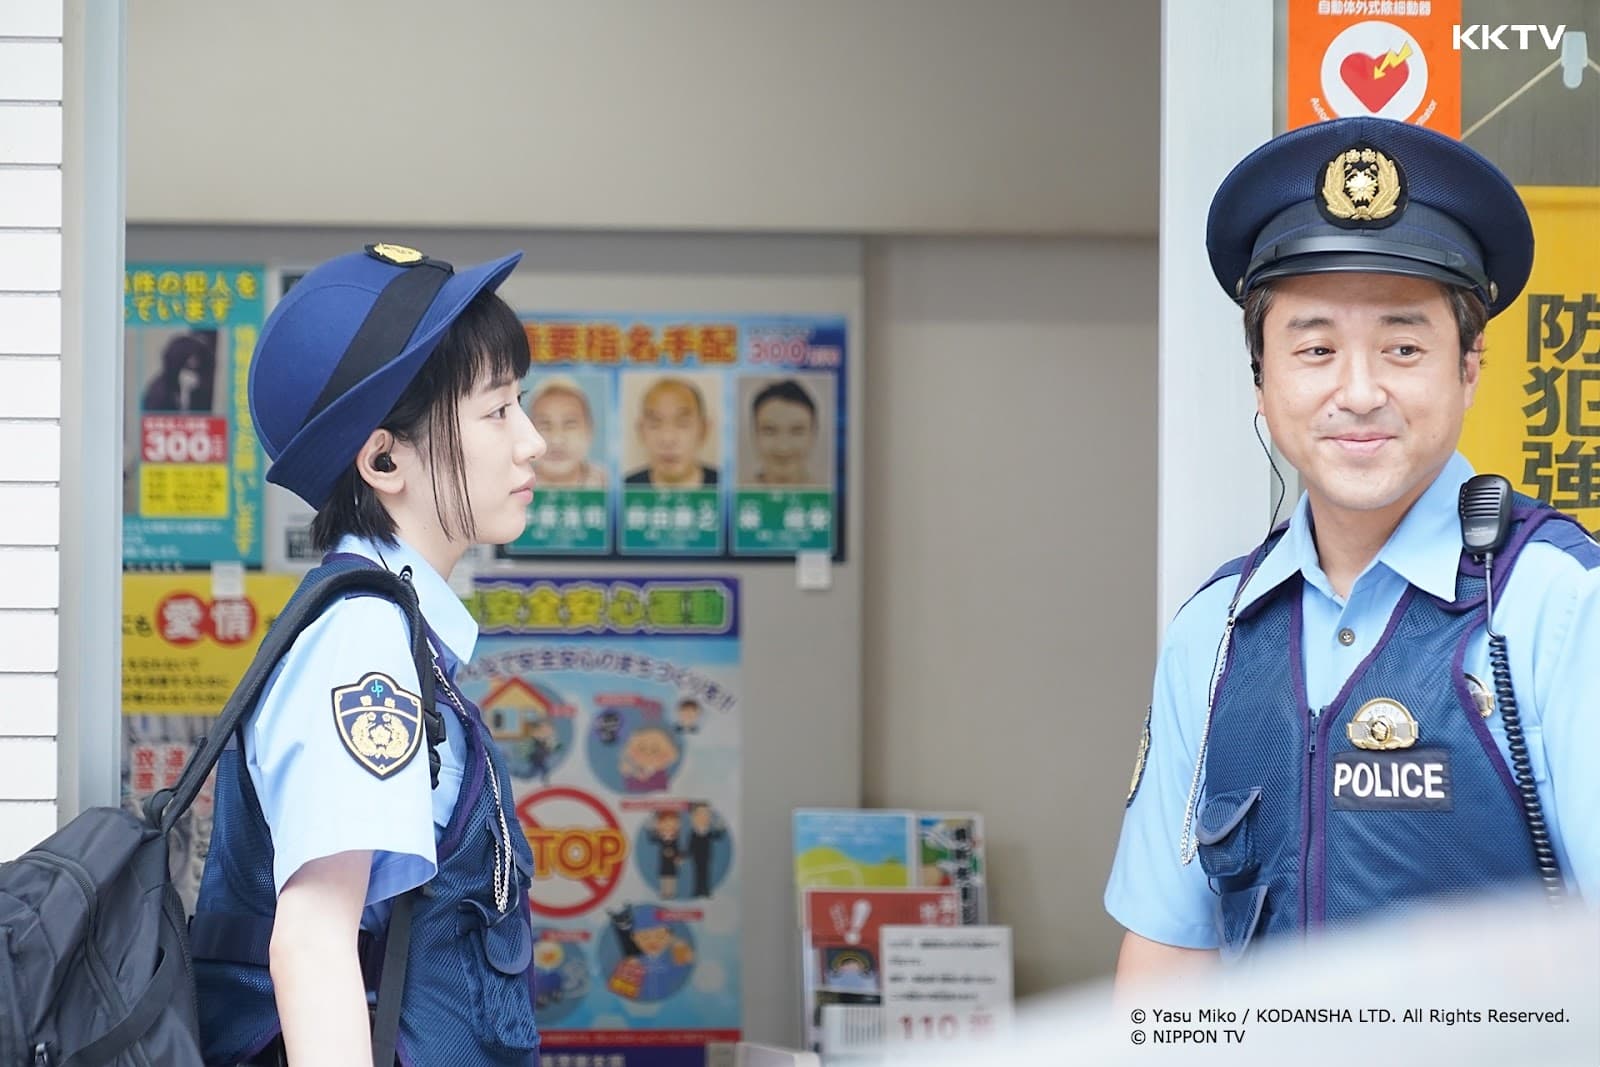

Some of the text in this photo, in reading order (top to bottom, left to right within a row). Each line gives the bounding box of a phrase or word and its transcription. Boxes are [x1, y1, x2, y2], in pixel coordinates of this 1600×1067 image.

[125, 296, 232, 321] ています
[1521, 293, 1600, 516] 防犯強
[163, 598, 250, 640] 愛情
[1333, 762, 1446, 799] POLICE
[528, 830, 625, 876] TOP
